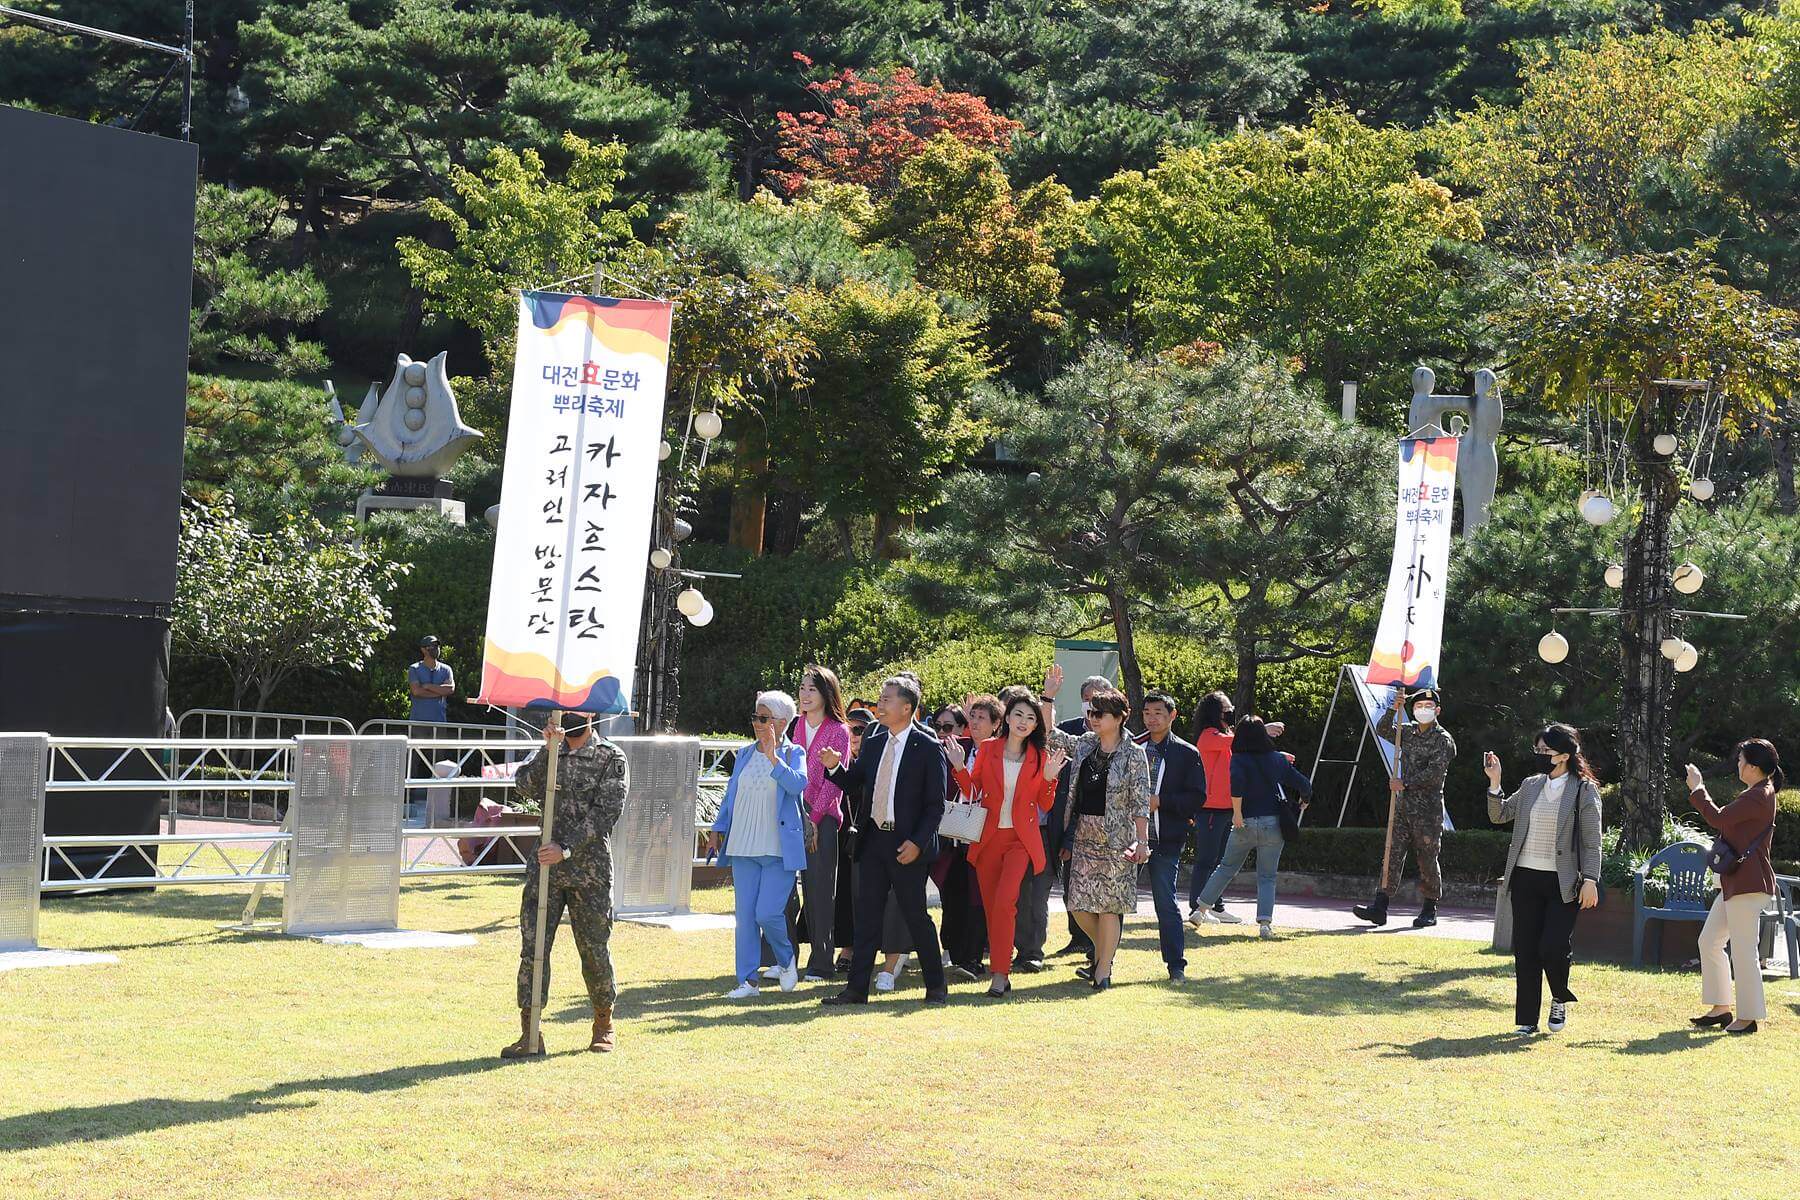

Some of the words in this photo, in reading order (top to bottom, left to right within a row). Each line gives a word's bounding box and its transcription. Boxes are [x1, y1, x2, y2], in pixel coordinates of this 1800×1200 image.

[543, 360, 640, 391] 대전효문화
[553, 394, 625, 418] 뿌리축제
[543, 435, 571, 523] 고려인
[568, 435, 621, 639] 카자흐스탄
[528, 544, 562, 634] 방문단
